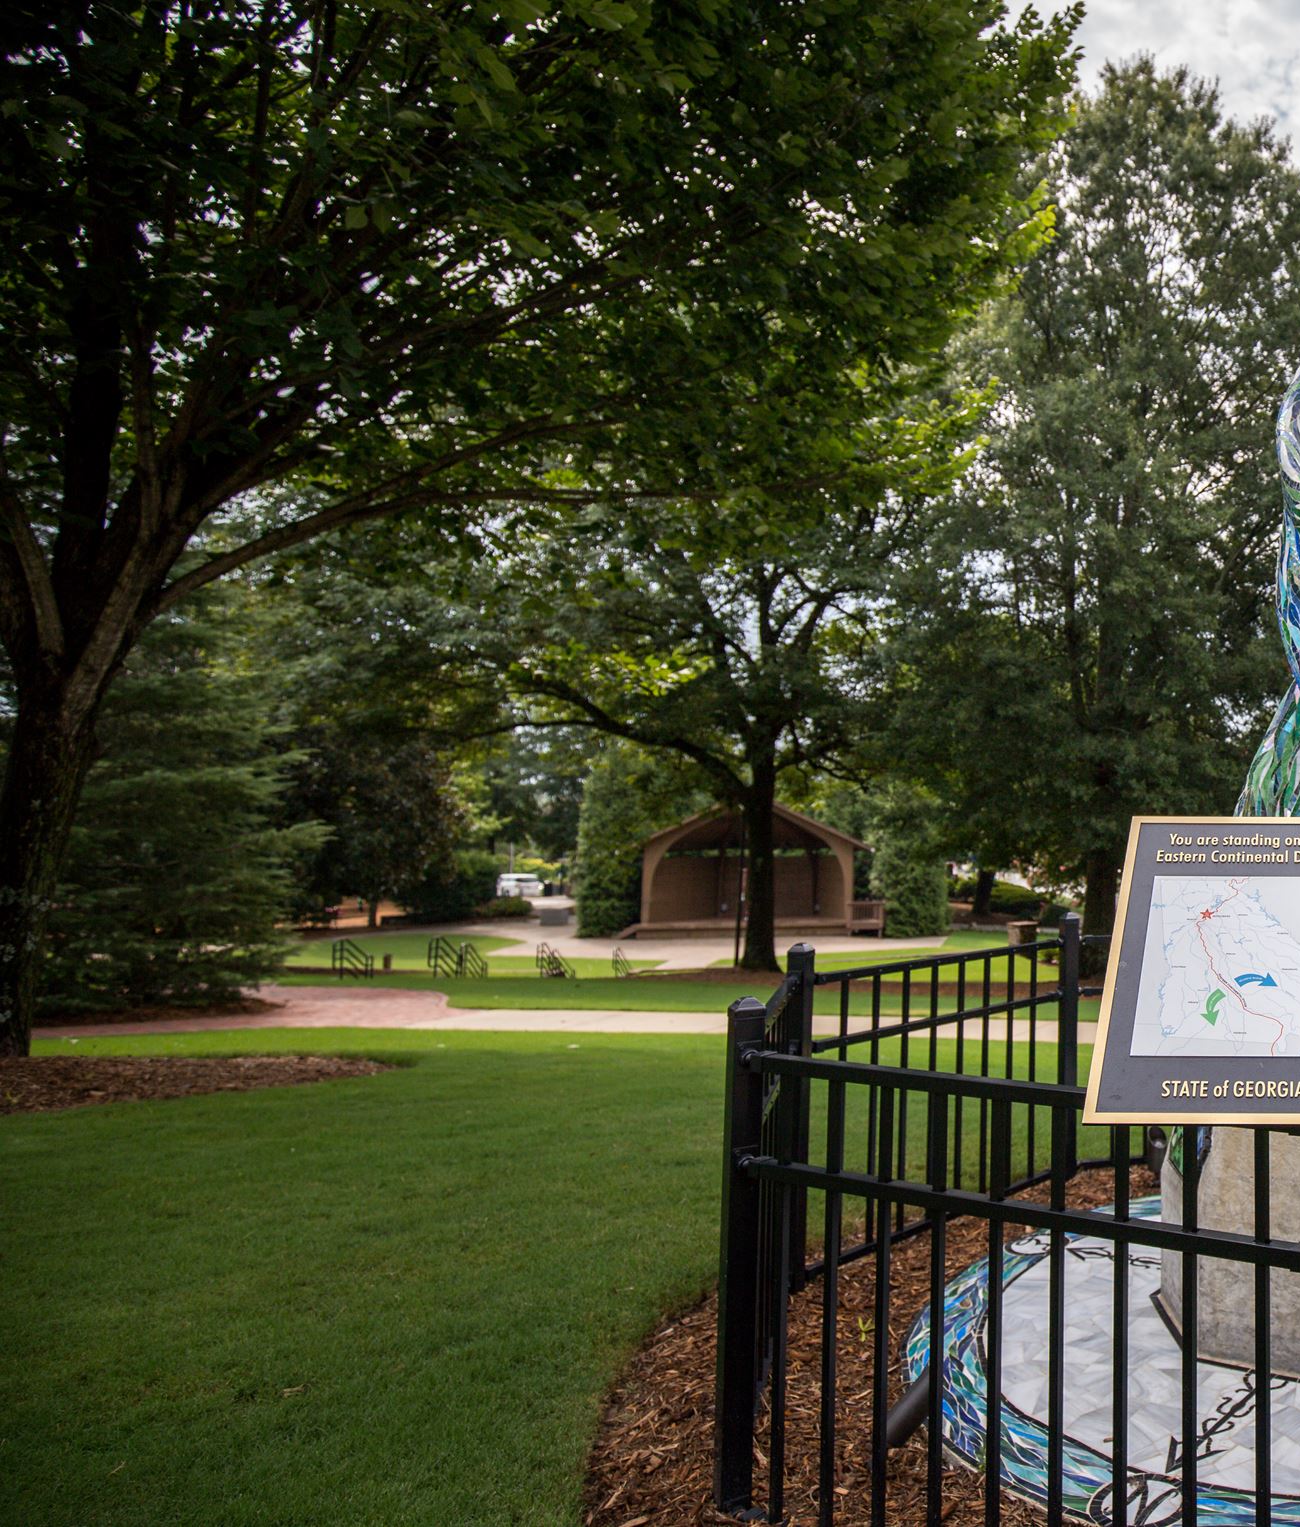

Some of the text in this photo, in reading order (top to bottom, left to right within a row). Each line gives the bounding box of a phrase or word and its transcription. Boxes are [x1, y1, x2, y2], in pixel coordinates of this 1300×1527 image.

[1170, 834, 1192, 846] You
[1197, 836, 1218, 846] are
[1222, 834, 1280, 849] standing
[1156, 850, 1206, 863] Eastern
[1211, 850, 1289, 863] Continental
[1161, 1080, 1208, 1098] STATE
[1214, 1080, 1230, 1098] of
